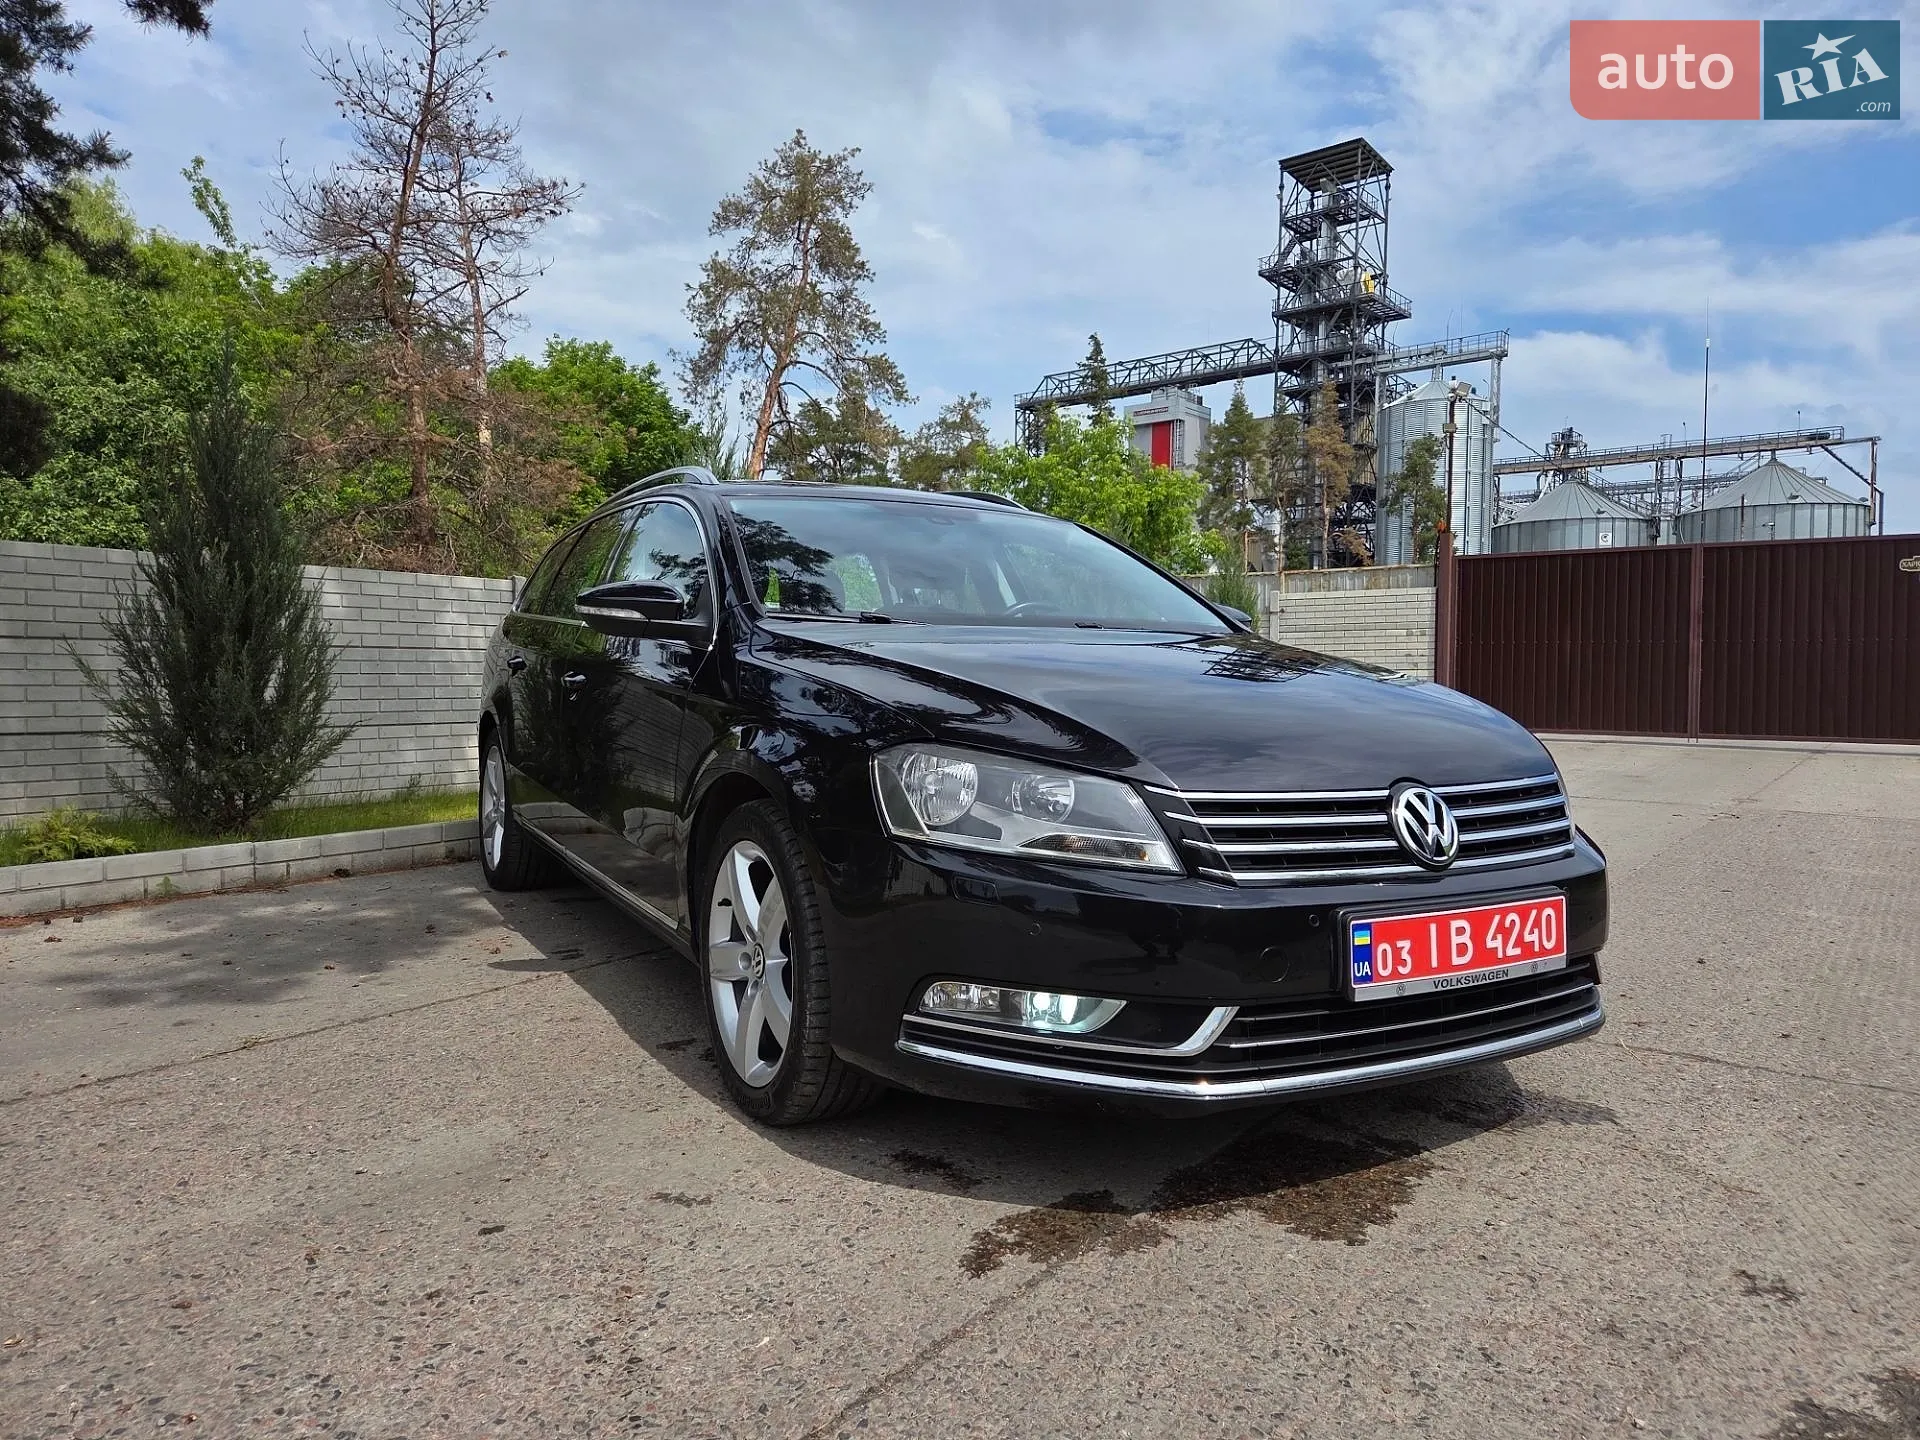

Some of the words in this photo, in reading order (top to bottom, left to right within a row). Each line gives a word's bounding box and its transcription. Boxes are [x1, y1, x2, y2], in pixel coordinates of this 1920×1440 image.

[1376, 939, 1412, 977] 03
[1485, 907, 1557, 959] 4240
[1354, 961, 1372, 977] UA
[1432, 969, 1509, 990] VOLKSWAGEN
